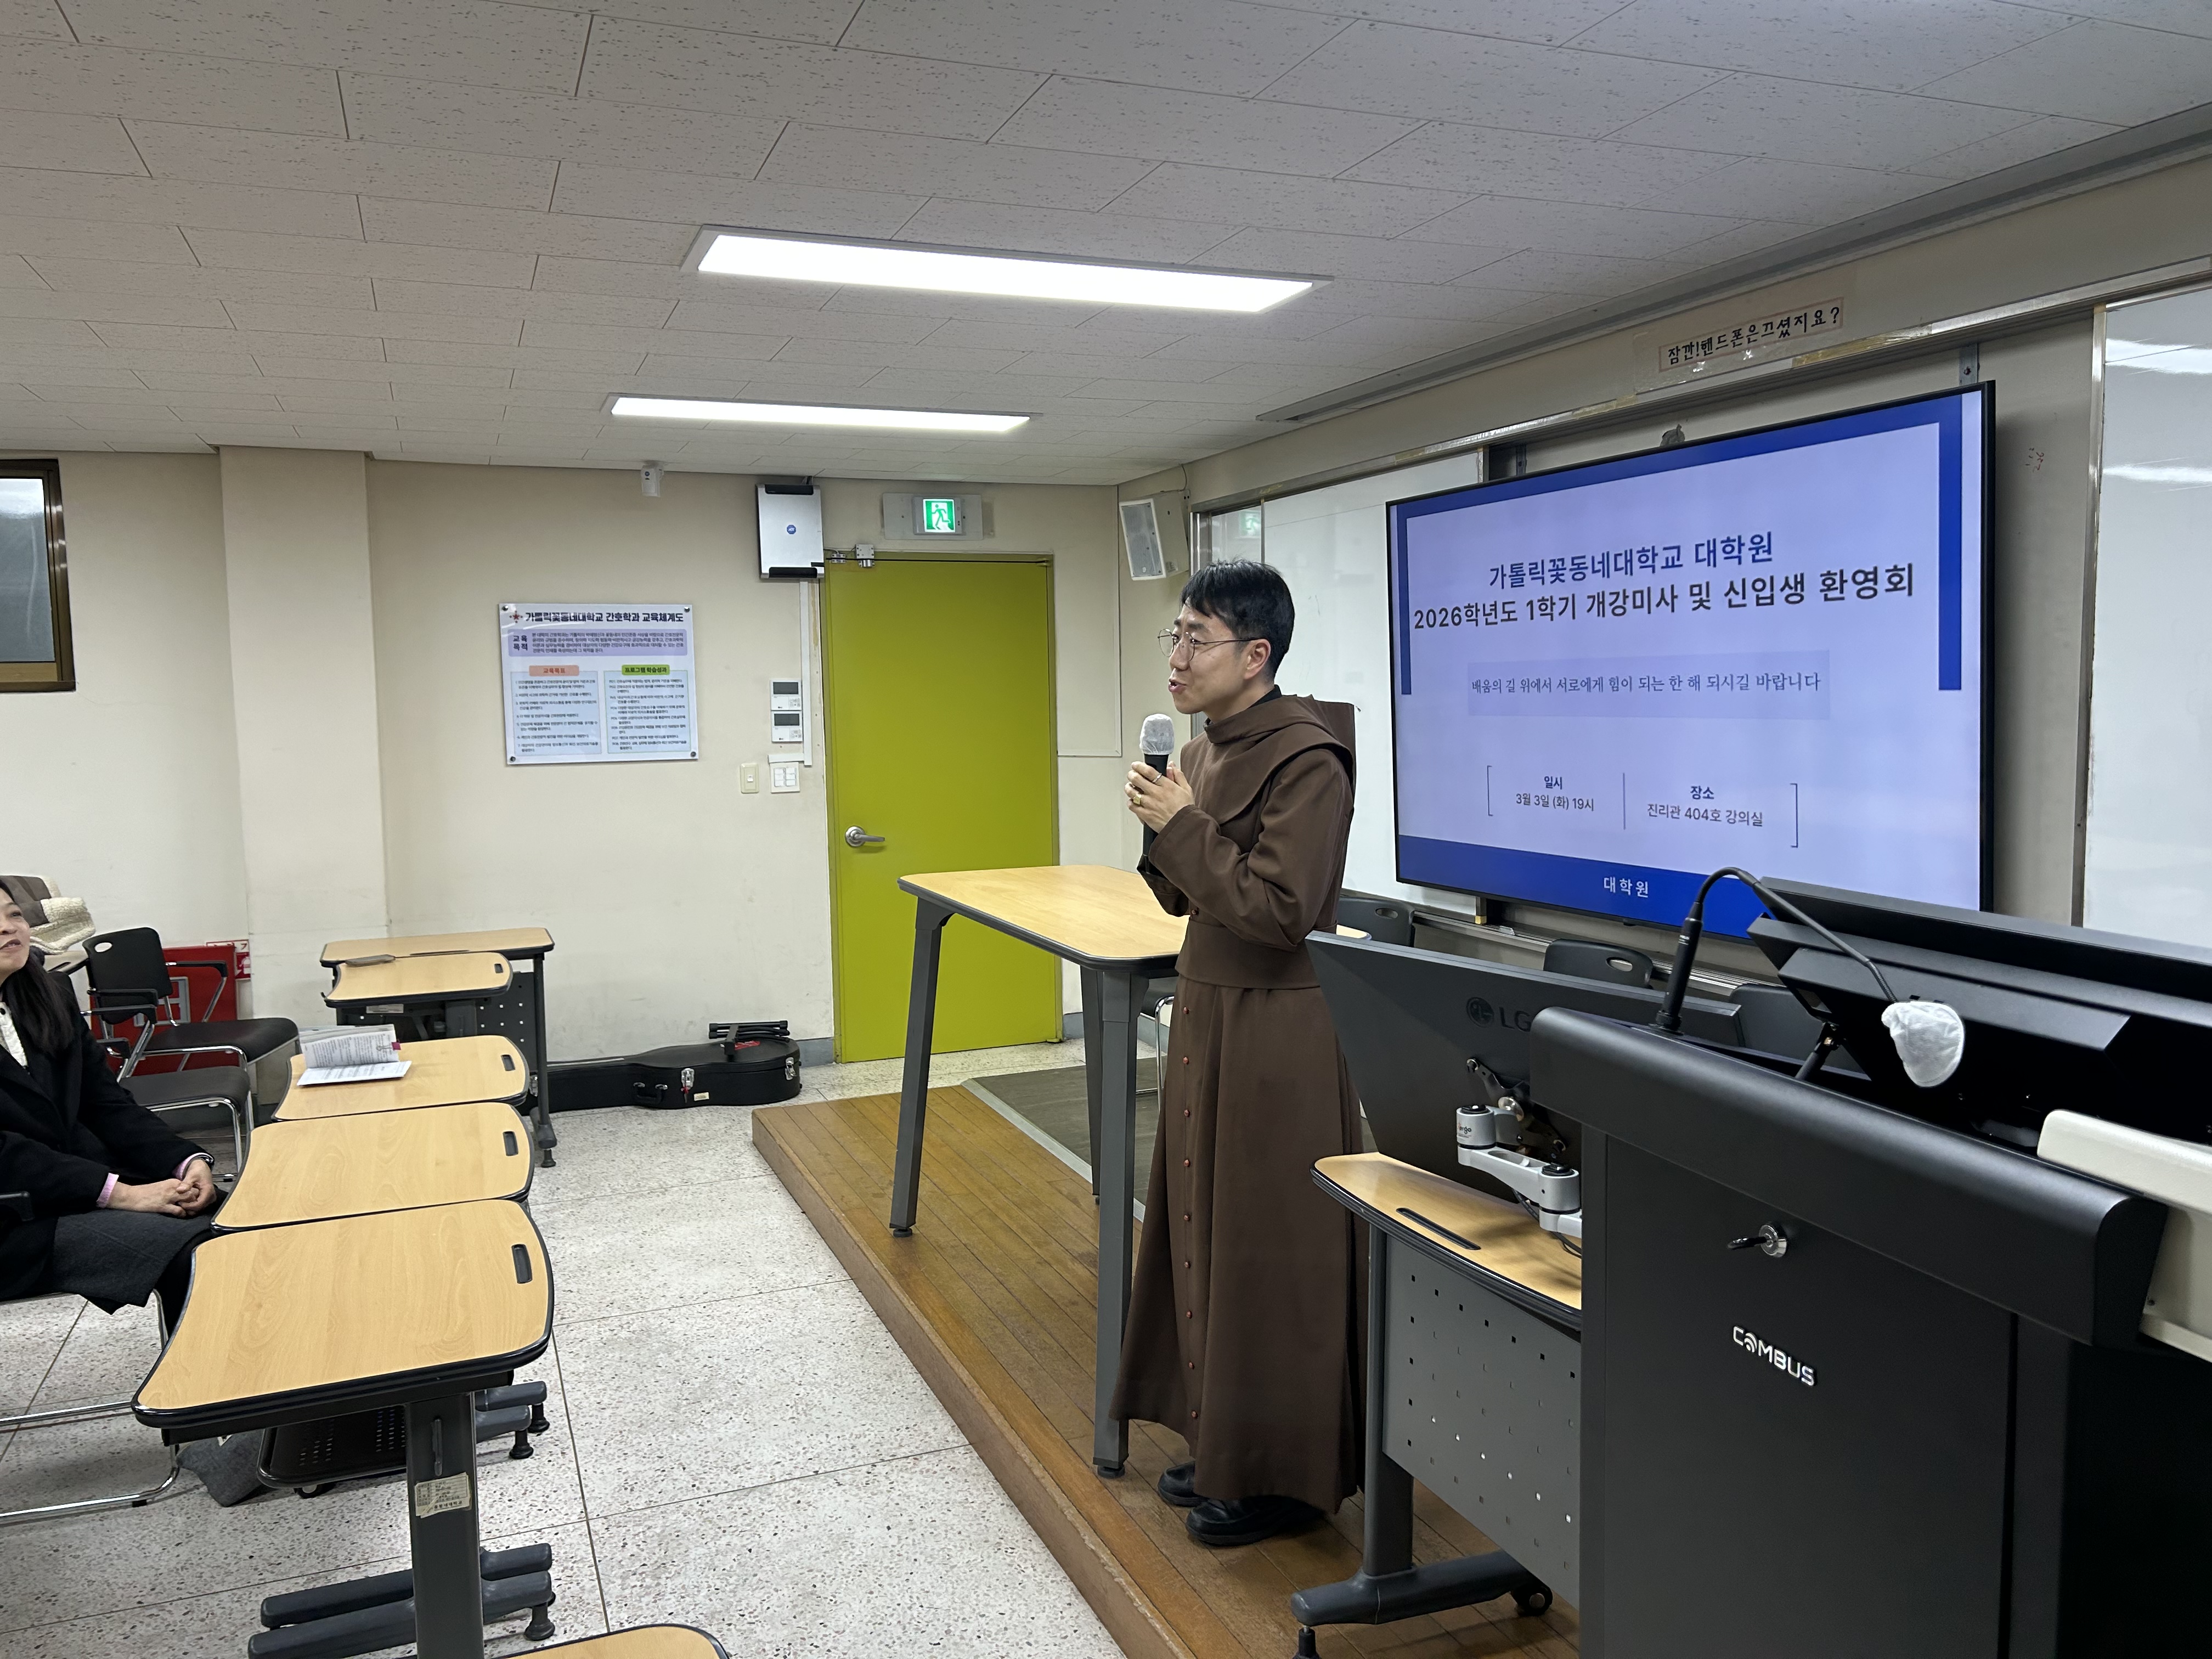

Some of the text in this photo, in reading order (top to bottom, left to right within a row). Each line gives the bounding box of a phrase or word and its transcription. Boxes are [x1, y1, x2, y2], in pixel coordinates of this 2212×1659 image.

[1489, 531, 1773, 590] 가톨릭꽃동네대학교 대학원
[1414, 563, 1912, 629] 2026학년도 1학기 개강미사 및 신입생 환영회
[606, 612, 640, 622] 간호학과
[642, 612, 684, 622] 교육체계도
[1472, 672, 1820, 694] 배움의 길 위에서 서로에게 힘이 되는 한 해 되시길 바랍니다
[1544, 776, 1562, 790] 일시
[1690, 785, 1714, 800] 장소
[1516, 793, 1594, 811] 3월 3일 (화) 19시
[1647, 804, 1763, 827] 진리관 404호 강의실
[1604, 877, 1649, 898] 대학원
[1499, 1007, 1532, 1032] LG
